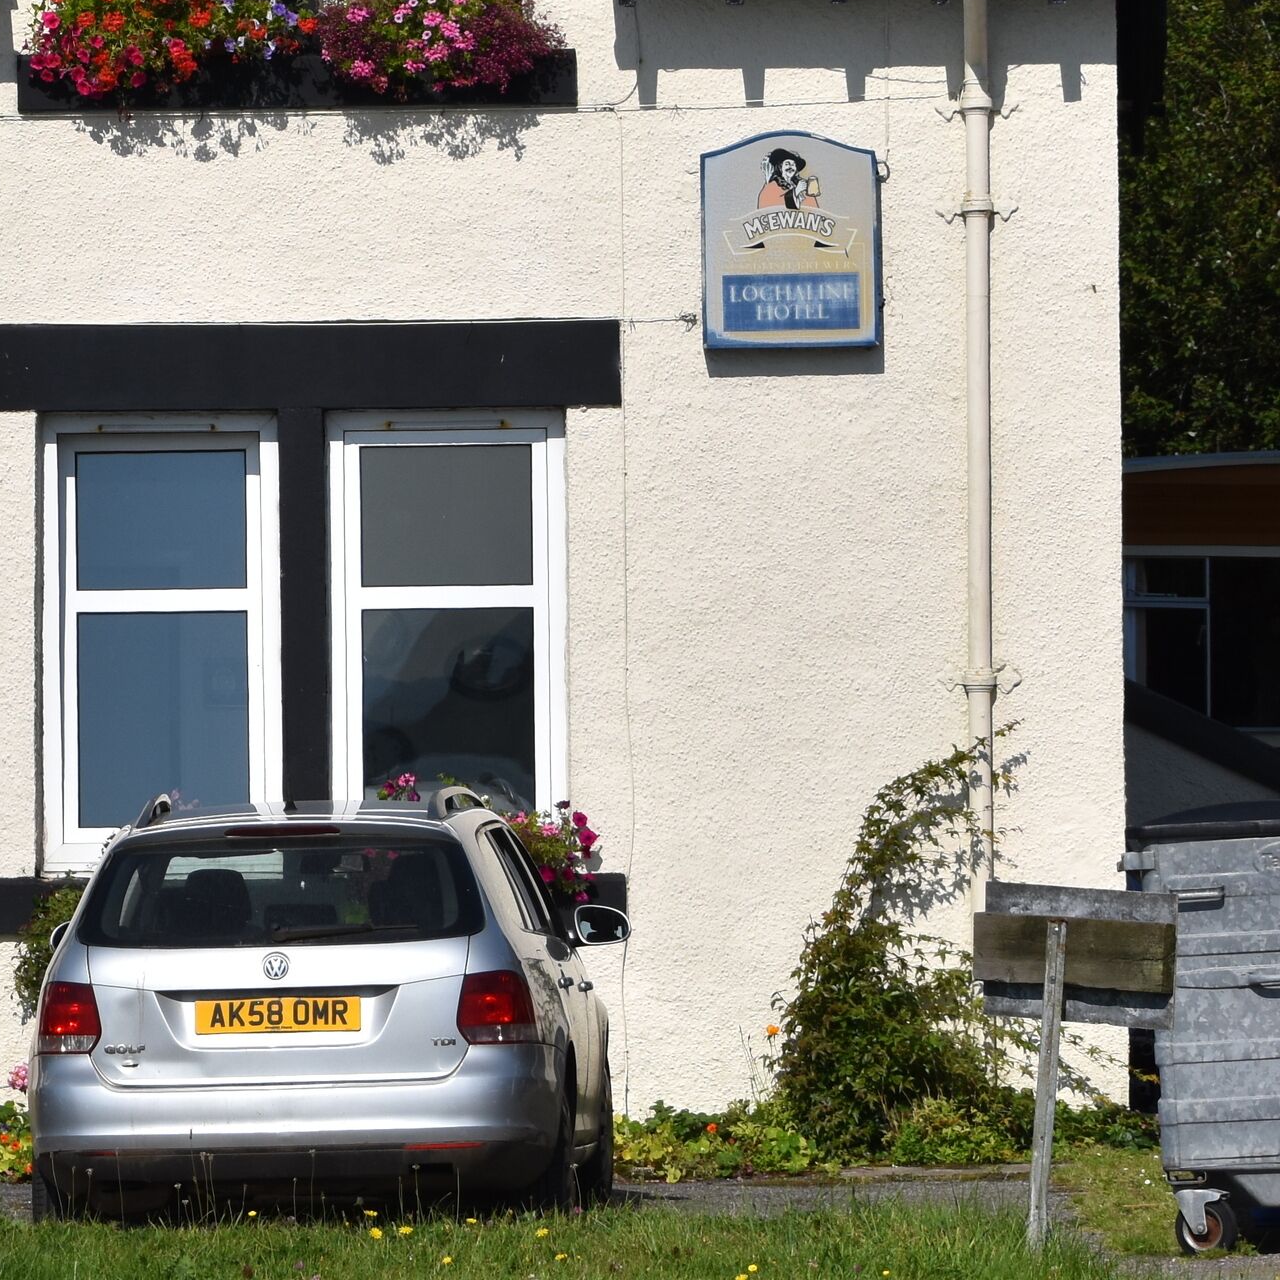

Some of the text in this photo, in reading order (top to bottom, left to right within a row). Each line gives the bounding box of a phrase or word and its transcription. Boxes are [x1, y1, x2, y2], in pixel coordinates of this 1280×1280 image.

[729, 282, 854, 302] LOCHALINE
[756, 303, 830, 320] HOTEL
[210, 999, 349, 1028] AK58 OMR
[104, 1044, 146, 1055] GOLF
[430, 1037, 456, 1047] TDI
